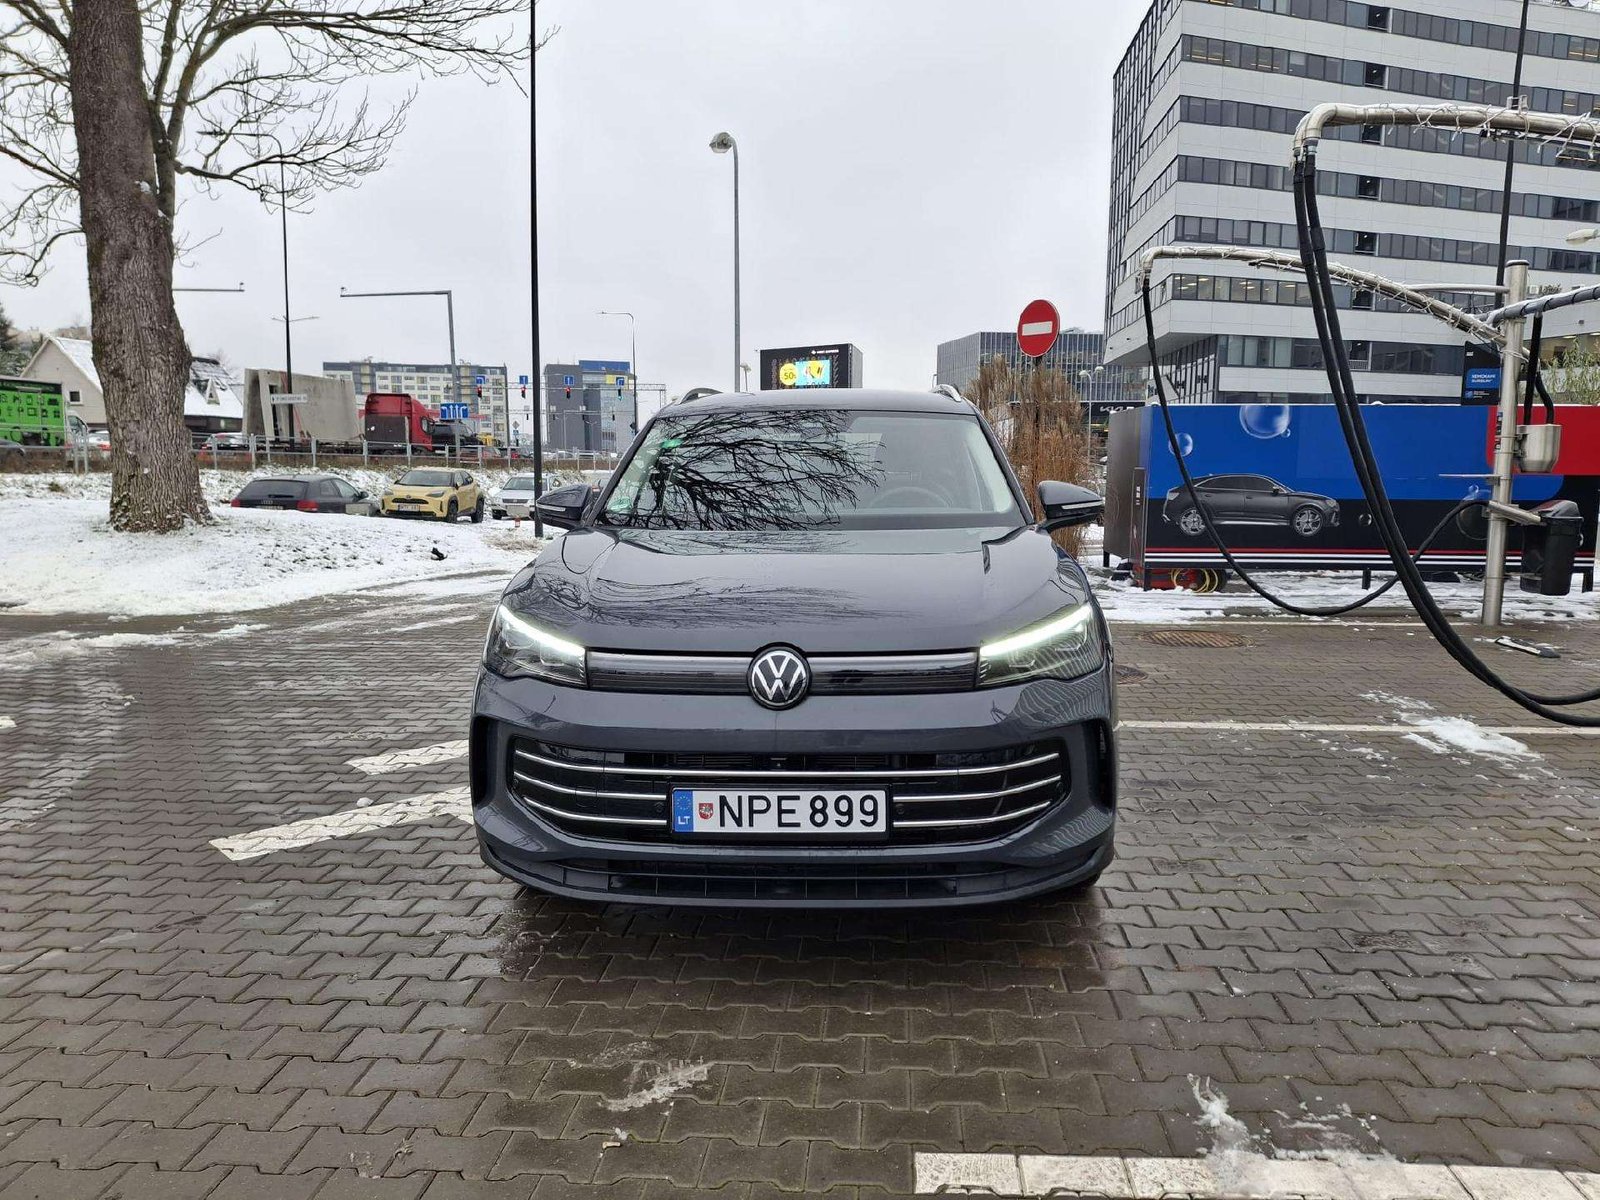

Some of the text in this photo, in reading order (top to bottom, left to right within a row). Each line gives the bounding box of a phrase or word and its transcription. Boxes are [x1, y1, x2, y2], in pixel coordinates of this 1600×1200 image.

[678, 815, 690, 825] LT
[719, 794, 879, 828] NPE 899
